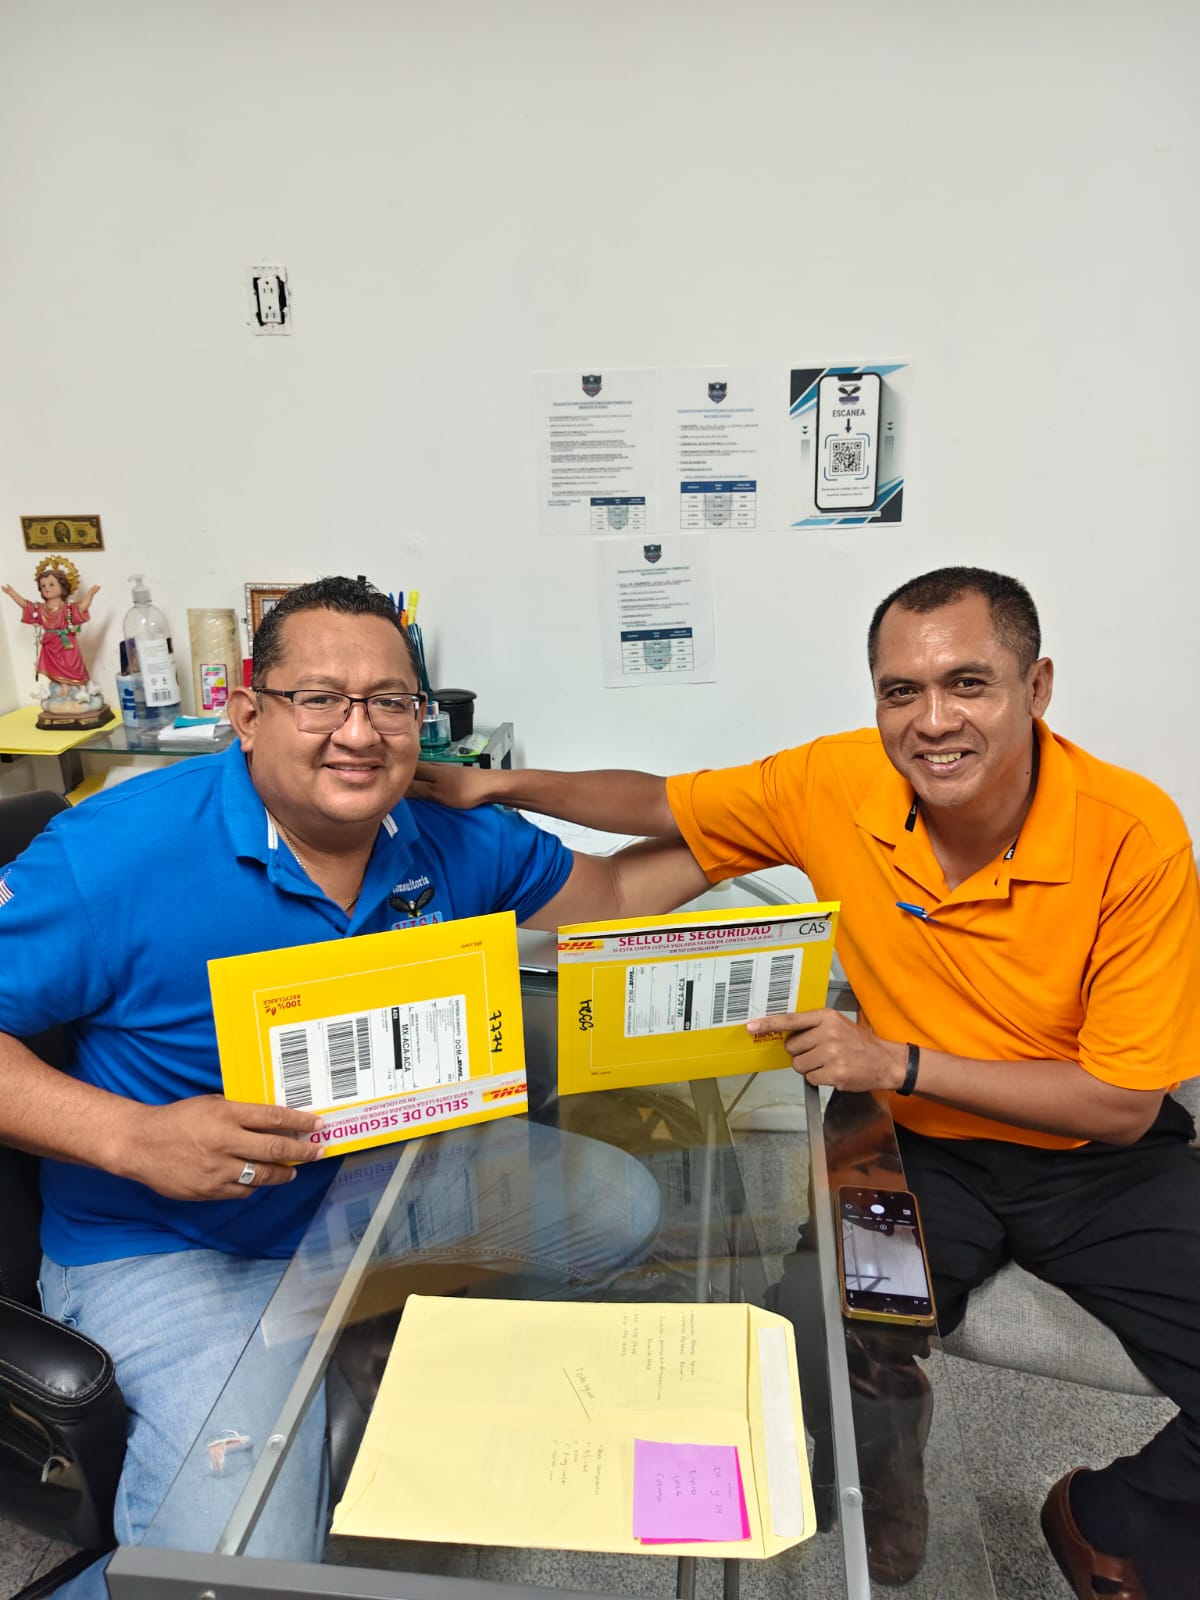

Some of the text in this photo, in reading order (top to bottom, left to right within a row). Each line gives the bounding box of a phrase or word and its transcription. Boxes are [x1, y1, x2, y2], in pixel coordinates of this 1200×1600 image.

[832, 408, 866, 418] ESCANEA
[798, 921, 826, 936] CAS
[618, 935, 663, 947] SELLO
[667, 932, 685, 943] DE
[689, 925, 772, 941] SEGURIDAD
[558, 941, 596, 951] DHL
[277, 1000, 302, 1010] 100%
[401, 1023, 411, 1073] MX-ACA-ACA
[489, 1083, 528, 1100] DHL
[436, 1094, 453, 1103] CINTA
[363, 1100, 398, 1113] LOCALIDAD
[389, 1102, 416, 1113] VIOLADA
[310, 1098, 469, 1144] SELLO DE SEGURIDAD
